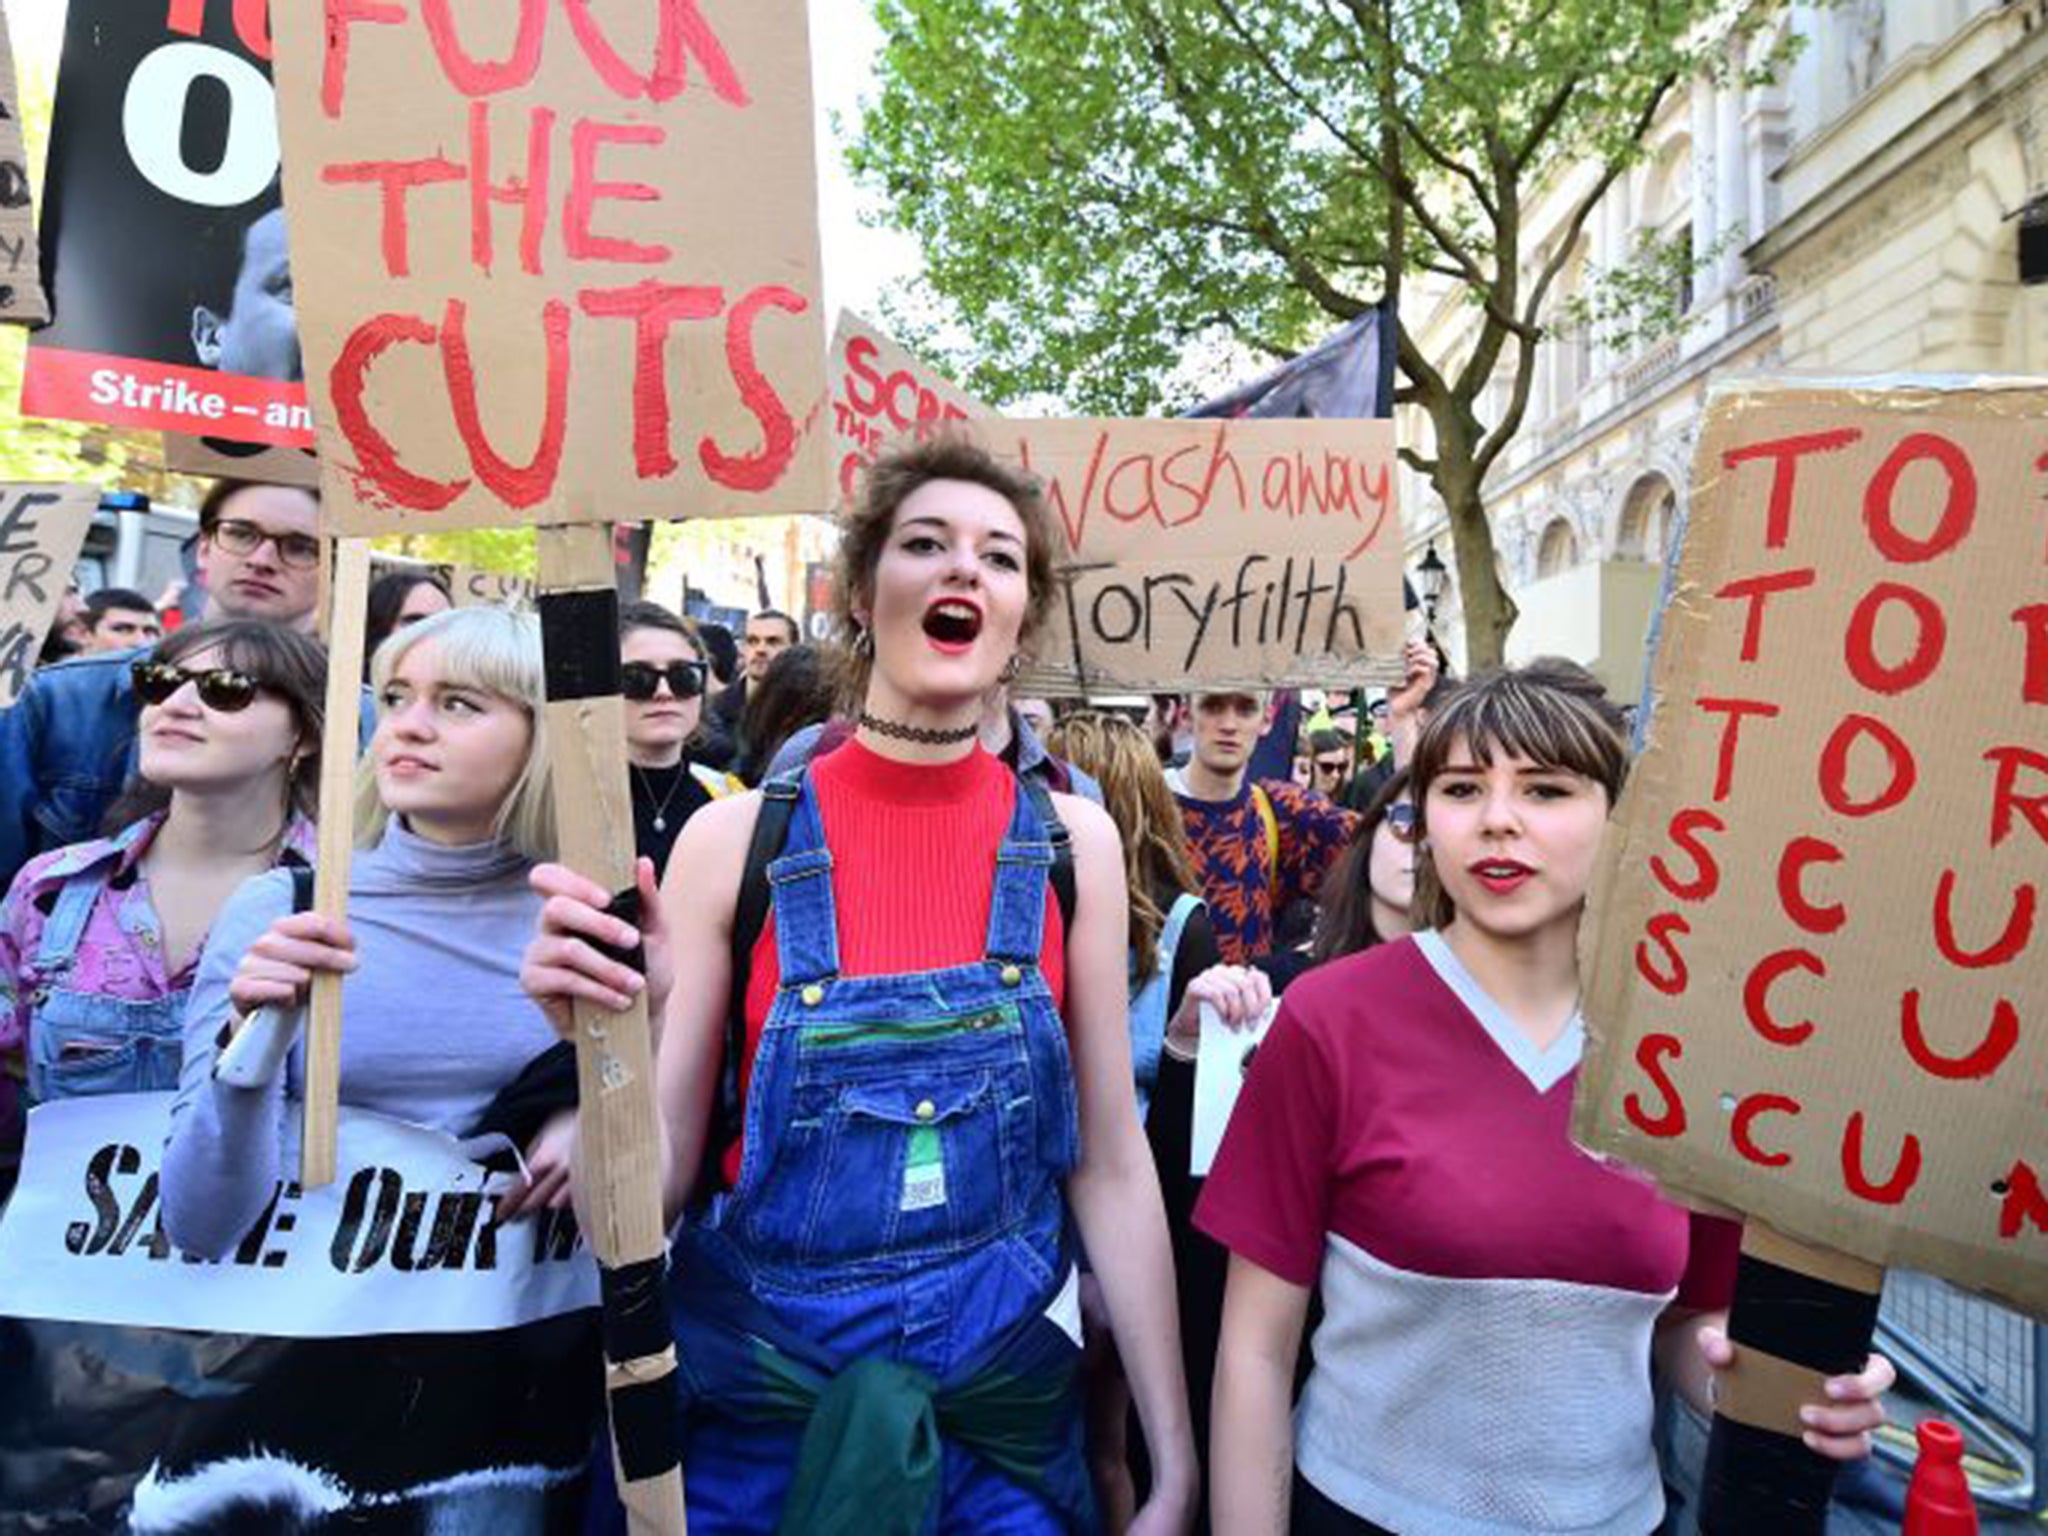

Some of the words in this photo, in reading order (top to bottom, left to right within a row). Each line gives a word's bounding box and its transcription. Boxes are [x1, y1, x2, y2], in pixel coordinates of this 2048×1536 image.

[320, 0, 752, 120] FUCK
[320, 100, 673, 278] THE
[89, 368, 227, 420] Strike
[328, 280, 808, 511] CUTS
[1018, 422, 1246, 552] Wash
[1262, 449, 1390, 561] away
[1722, 427, 2048, 564] TO
[65, 1143, 304, 1268] SAE
